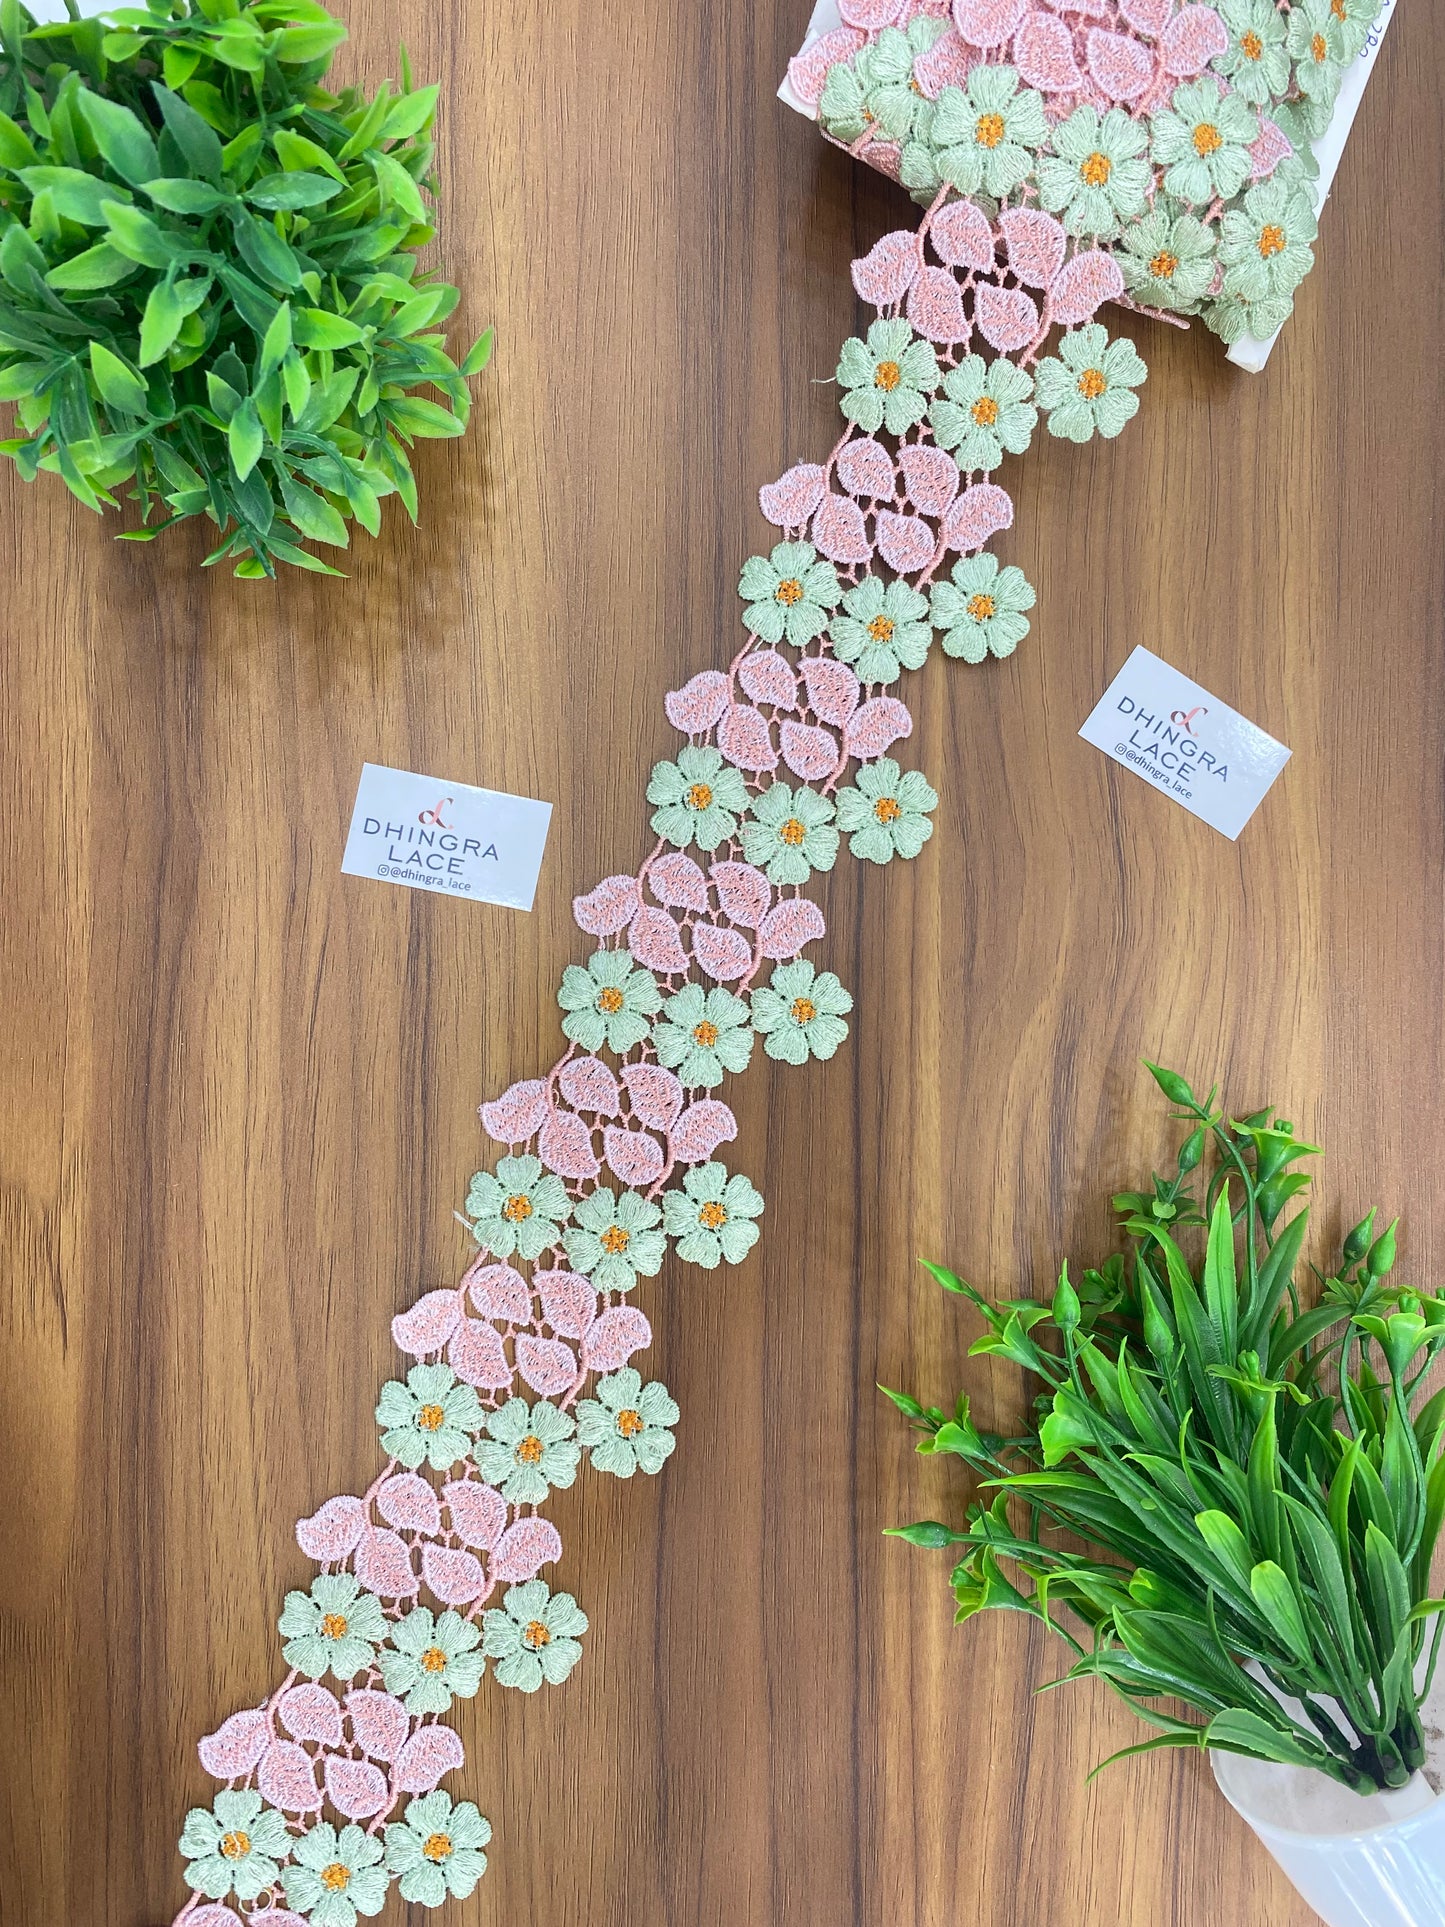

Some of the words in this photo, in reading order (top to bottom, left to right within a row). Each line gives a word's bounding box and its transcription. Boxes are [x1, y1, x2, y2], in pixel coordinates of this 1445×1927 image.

[1117, 696, 1229, 783] DHINGRA
[1128, 729, 1197, 782] LACE
[363, 817, 499, 861] DHINGRA
[388, 845, 466, 876] LACE
